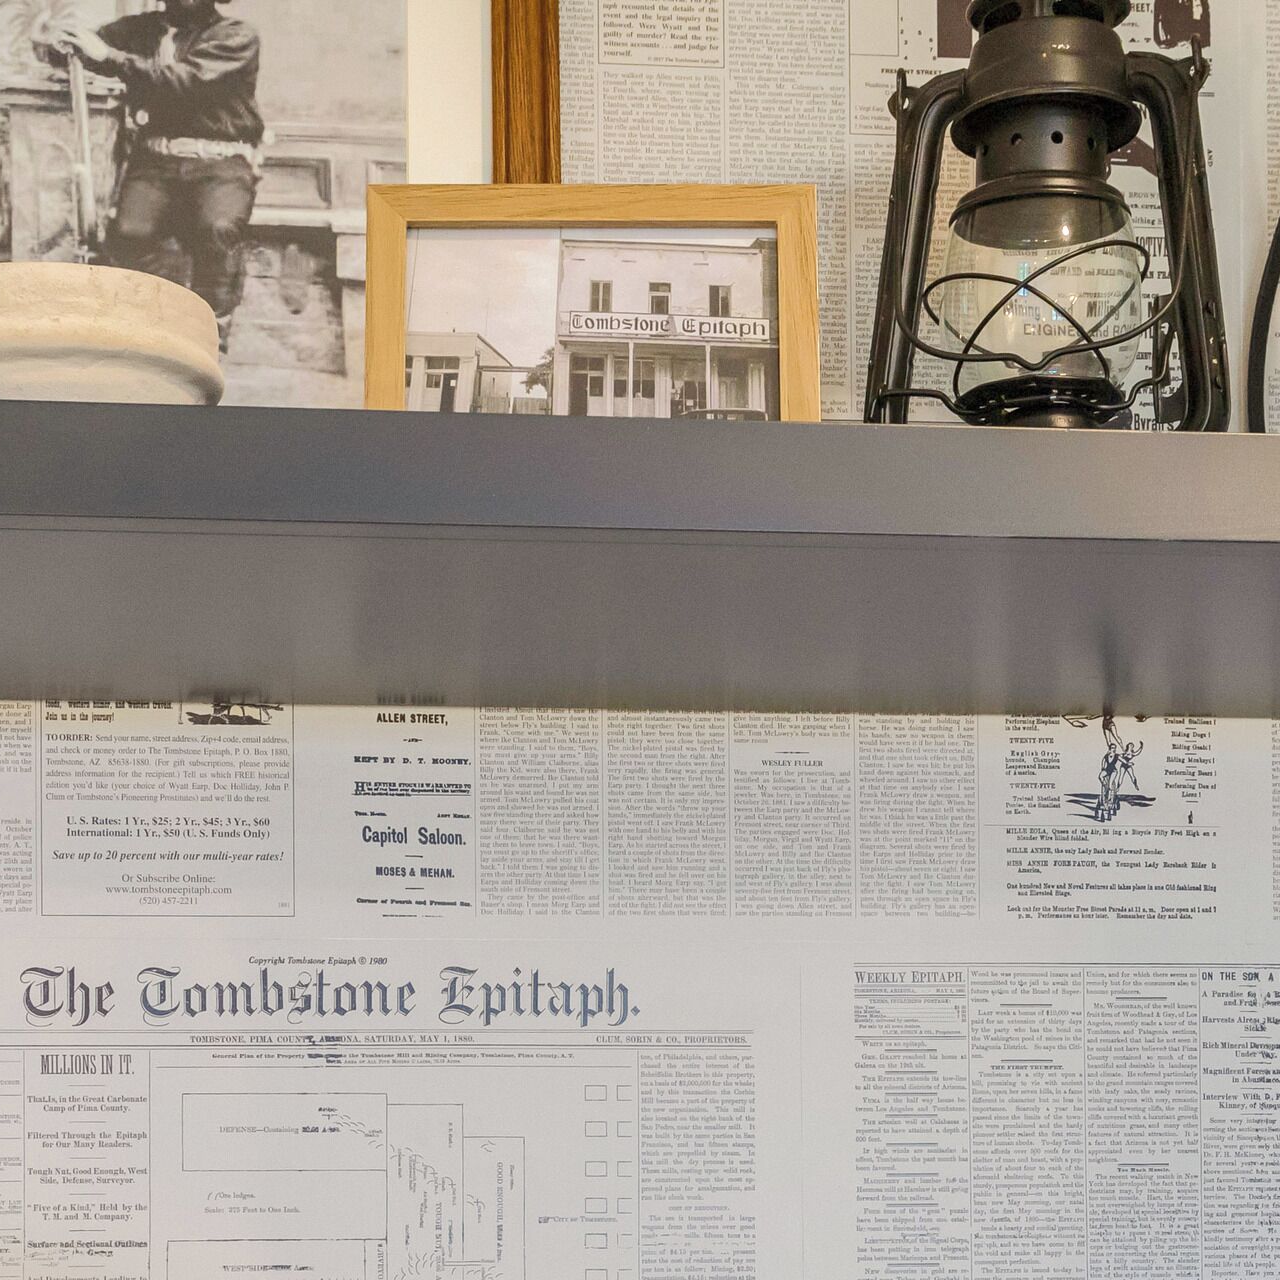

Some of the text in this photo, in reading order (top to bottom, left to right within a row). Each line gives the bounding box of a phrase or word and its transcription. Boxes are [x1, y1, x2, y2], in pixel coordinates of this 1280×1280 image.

[572, 314, 766, 336] Tombstone Epitaph
[376, 713, 448, 726] ALLEN STREET,
[79, 816, 89, 825] S.
[92, 816, 121, 825] Rates:
[132, 816, 150, 826] Yr.,
[152, 816, 172, 826] $25;
[183, 817, 200, 826] Yr.,
[202, 817, 223, 827] $45;
[234, 817, 251, 827] Yr.,
[253, 817, 270, 827] $60
[67, 828, 132, 837] International:
[144, 828, 161, 838] Yr.,
[163, 828, 180, 838] $50
[182, 828, 197, 838] (U.
[199, 829, 208, 838] S.
[243, 829, 270, 840] Only)
[362, 825, 466, 847] Capitol Saloon.
[52, 850, 75, 860] Save
[78, 853, 91, 862] up
[93, 851, 103, 860] to
[105, 850, 118, 860] 20
[119, 852, 156, 862] percent
[159, 850, 180, 861] with
[202, 851, 254, 863] multi-year
[255, 851, 284, 861] rates!
[376, 866, 406, 877] MOSES
[420, 867, 455, 878] MEHAN.
[121, 873, 216, 884] Or Subscribe Online:
[105, 885, 232, 896] www.tombstoneepitaph.com
[248, 956, 286, 967] Copyright
[288, 956, 326, 965] Tombstone
[327, 956, 357, 966] Epitaph
[358, 956, 367, 965] ©
[855, 971, 966, 984] WEEKLY EPITAPH.
[19, 966, 640, 1028] The Tombstone Epitaph.
[364, 1035, 416, 1044] SATURDAY,
[420, 1035, 440, 1044] MAY
[453, 1035, 475, 1044] 1880.
[40, 1054, 134, 1075] MILLIONS IN IT.
